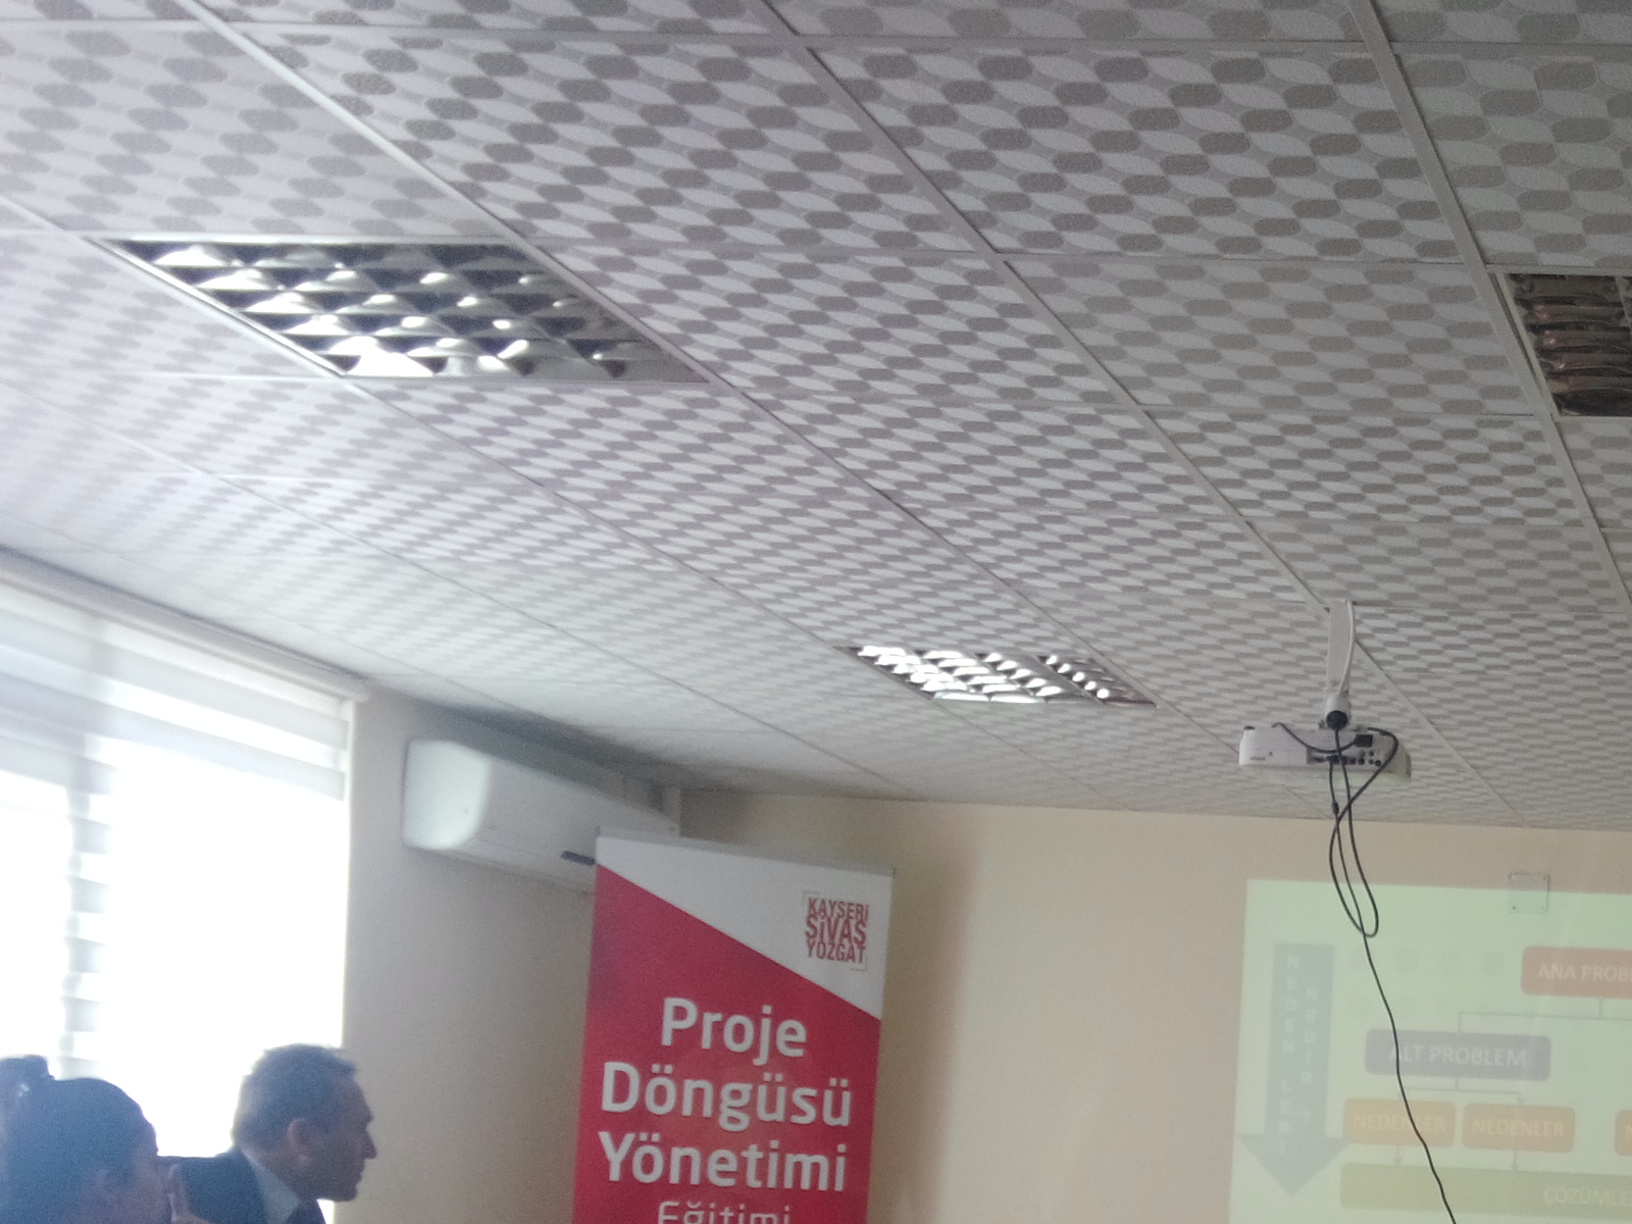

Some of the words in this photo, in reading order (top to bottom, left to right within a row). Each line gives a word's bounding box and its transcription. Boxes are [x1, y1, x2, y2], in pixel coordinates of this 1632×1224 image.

[806, 940, 867, 964] YOZGAT
[1537, 963, 1577, 981] ANA
[661, 996, 808, 1067] Proje
[1388, 1043, 1425, 1063] ALT
[1430, 1045, 1528, 1067] PROBLEM
[601, 1061, 853, 1133] Döngüsü
[1471, 1117, 1567, 1138] NEDENLER
[598, 1131, 848, 1192] Yönetimi
